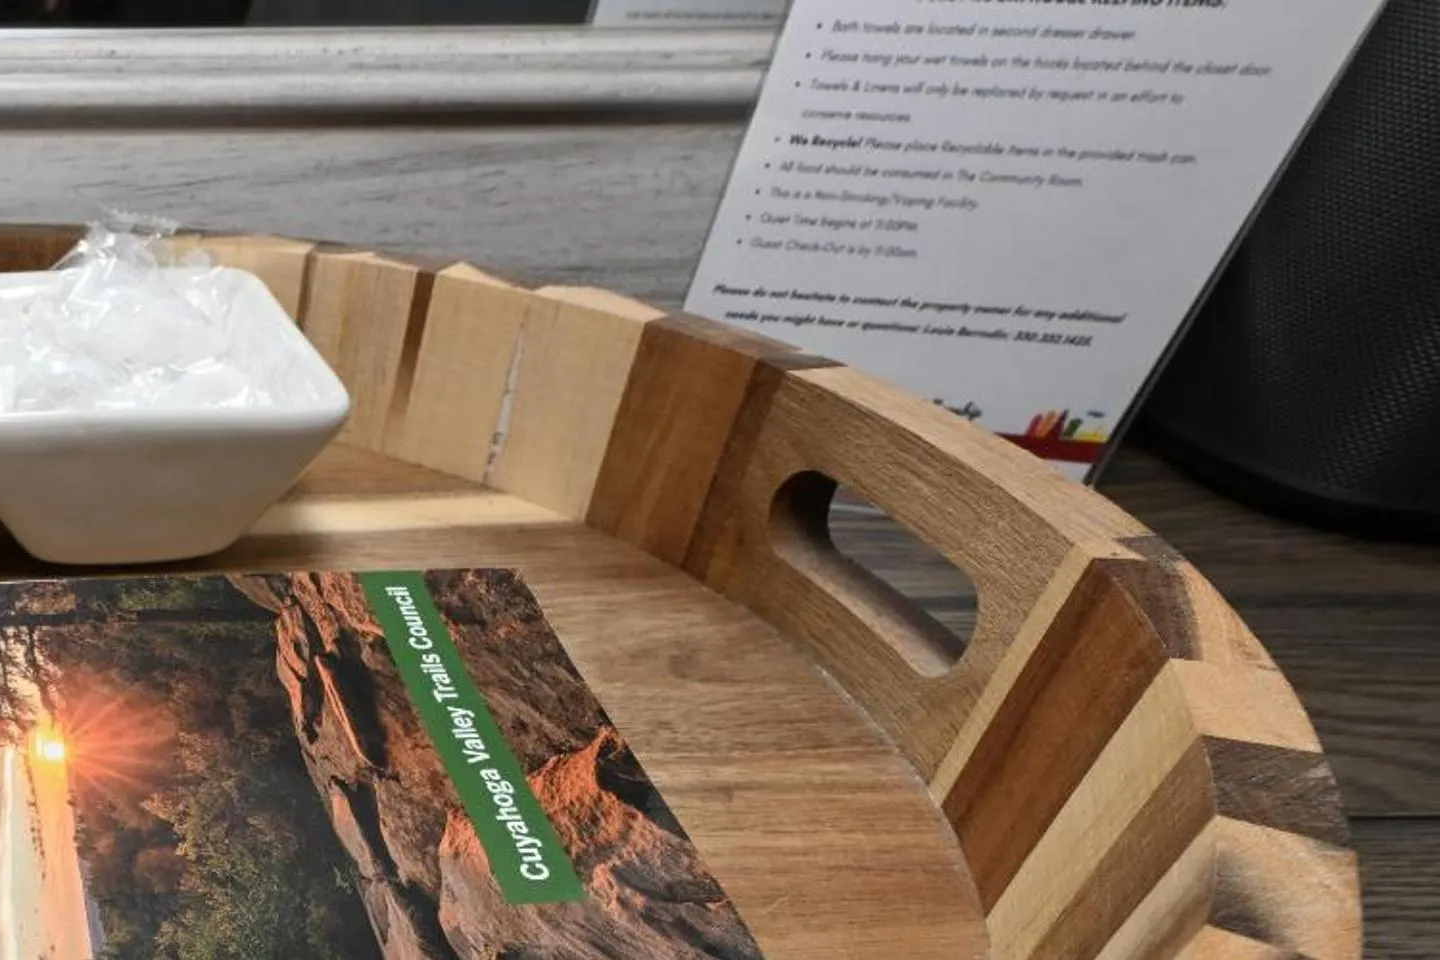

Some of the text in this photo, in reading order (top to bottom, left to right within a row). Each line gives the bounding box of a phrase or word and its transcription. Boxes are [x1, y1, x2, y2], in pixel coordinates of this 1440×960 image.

[863, 22, 900, 34] towels
[904, 24, 924, 34] are
[927, 23, 977, 36] located
[992, 25, 1040, 36] second
[821, 49, 859, 62] Please
[862, 53, 894, 67] hang
[894, 54, 920, 66] your
[923, 56, 947, 65] wet
[949, 54, 988, 66] towels
[1012, 55, 1031, 67] the
[1034, 56, 1069, 69] hooks
[1072, 56, 1122, 71] located
[1124, 59, 1172, 73] behind
[1172, 61, 1194, 73] the
[1196, 62, 1238, 74] closet
[810, 78, 849, 91] Towels
[902, 82, 925, 93] will
[924, 82, 949, 98] only
[1047, 90, 1094, 102] request
[1130, 90, 1169, 103] effort
[790, 134, 809, 146] We
[811, 134, 863, 149] Recycle!
[864, 137, 902, 150] Please
[904, 140, 938, 152] place
[1076, 149, 1136, 162] provided
[797, 163, 823, 173] food
[825, 163, 862, 175] should
[881, 167, 940, 179] consumed
[979, 170, 1044, 188] Community
[760, 211, 791, 224] Quiet
[820, 215, 857, 231] begins
[750, 236, 782, 249] Guest
[713, 284, 751, 296] Please
[769, 290, 790, 298] not
[790, 289, 836, 301] hesitate
[852, 297, 898, 306] contact
[900, 297, 919, 308] the
[919, 302, 971, 315] property
[973, 306, 1012, 314] owner
[1013, 304, 1032, 316] for
[1033, 310, 1057, 321] any
[1057, 309, 1128, 323] additional
[725, 310, 759, 320] needs
[760, 315, 780, 323] you
[782, 313, 816, 326] might
[817, 316, 844, 326] have
[385, 586, 550, 881] Cuyahoga Valley Trails Council
